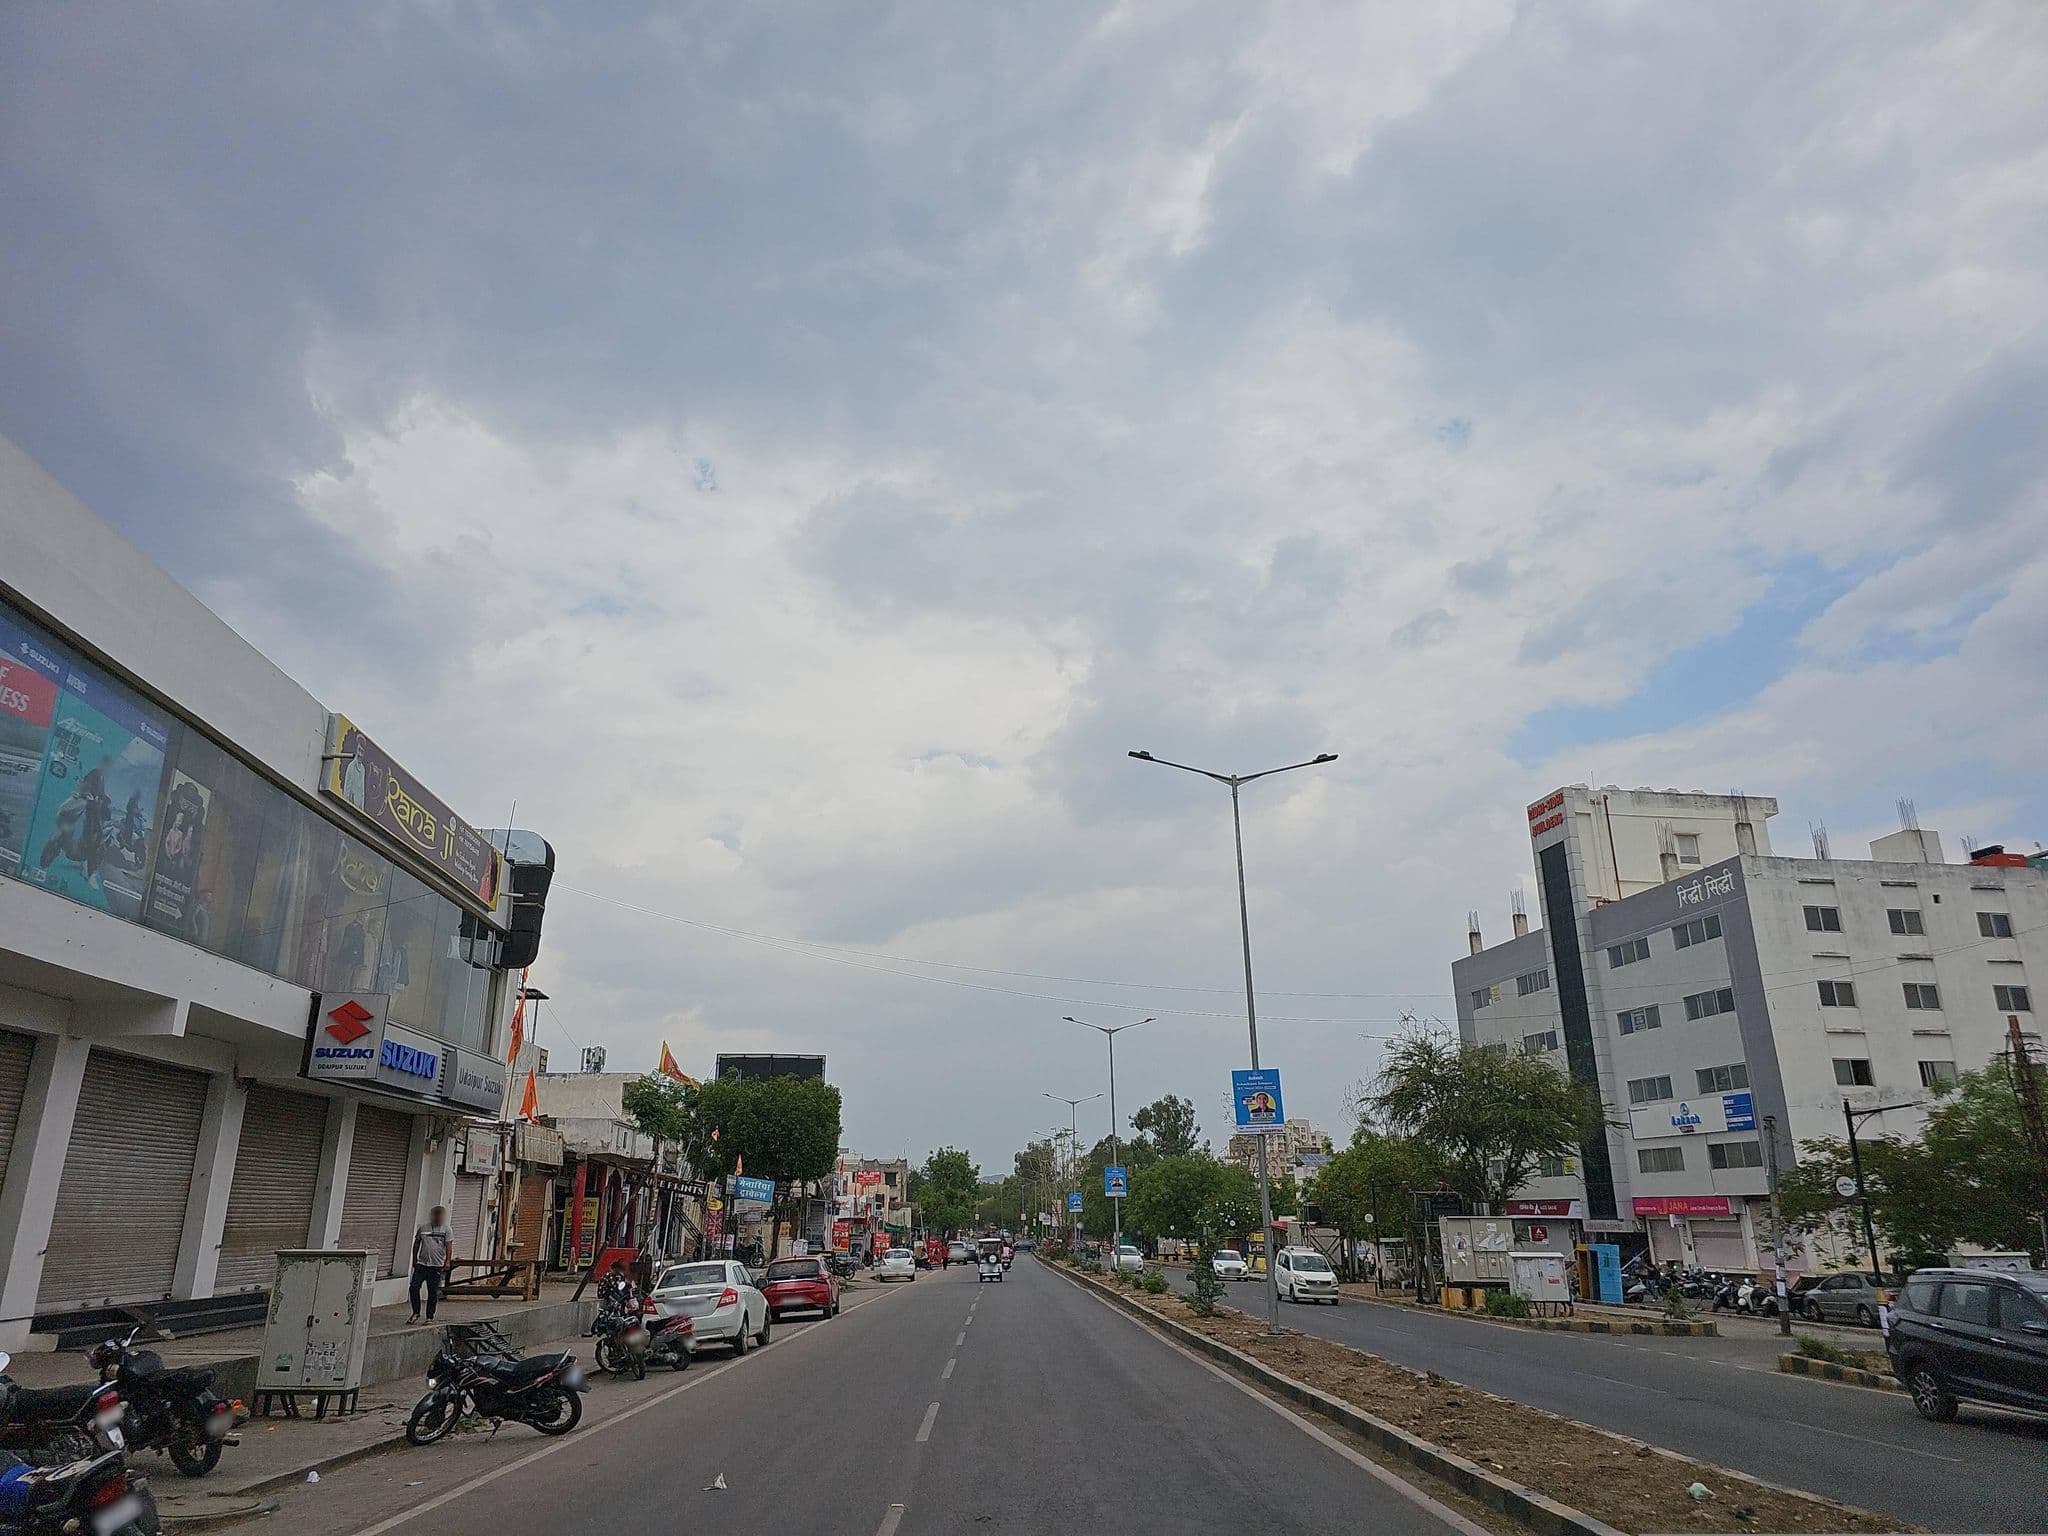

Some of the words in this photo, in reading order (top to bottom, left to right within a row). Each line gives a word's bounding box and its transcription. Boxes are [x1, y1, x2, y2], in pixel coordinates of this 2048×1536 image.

[29, 649, 60, 675] SUZUKI
[0, 685, 30, 712] ESS
[1532, 812, 1564, 838] BUILDERS
[315, 1047, 374, 1059] SUZUKI
[380, 1039, 438, 1080] SUZUKI
[317, 1063, 343, 1071] UDAIPUR
[345, 1063, 367, 1071] SUZUKI
[459, 1068, 482, 1091] Udaipur
[483, 1075, 504, 1097] Suzuki
[667, 1181, 704, 1195] PRINTS
